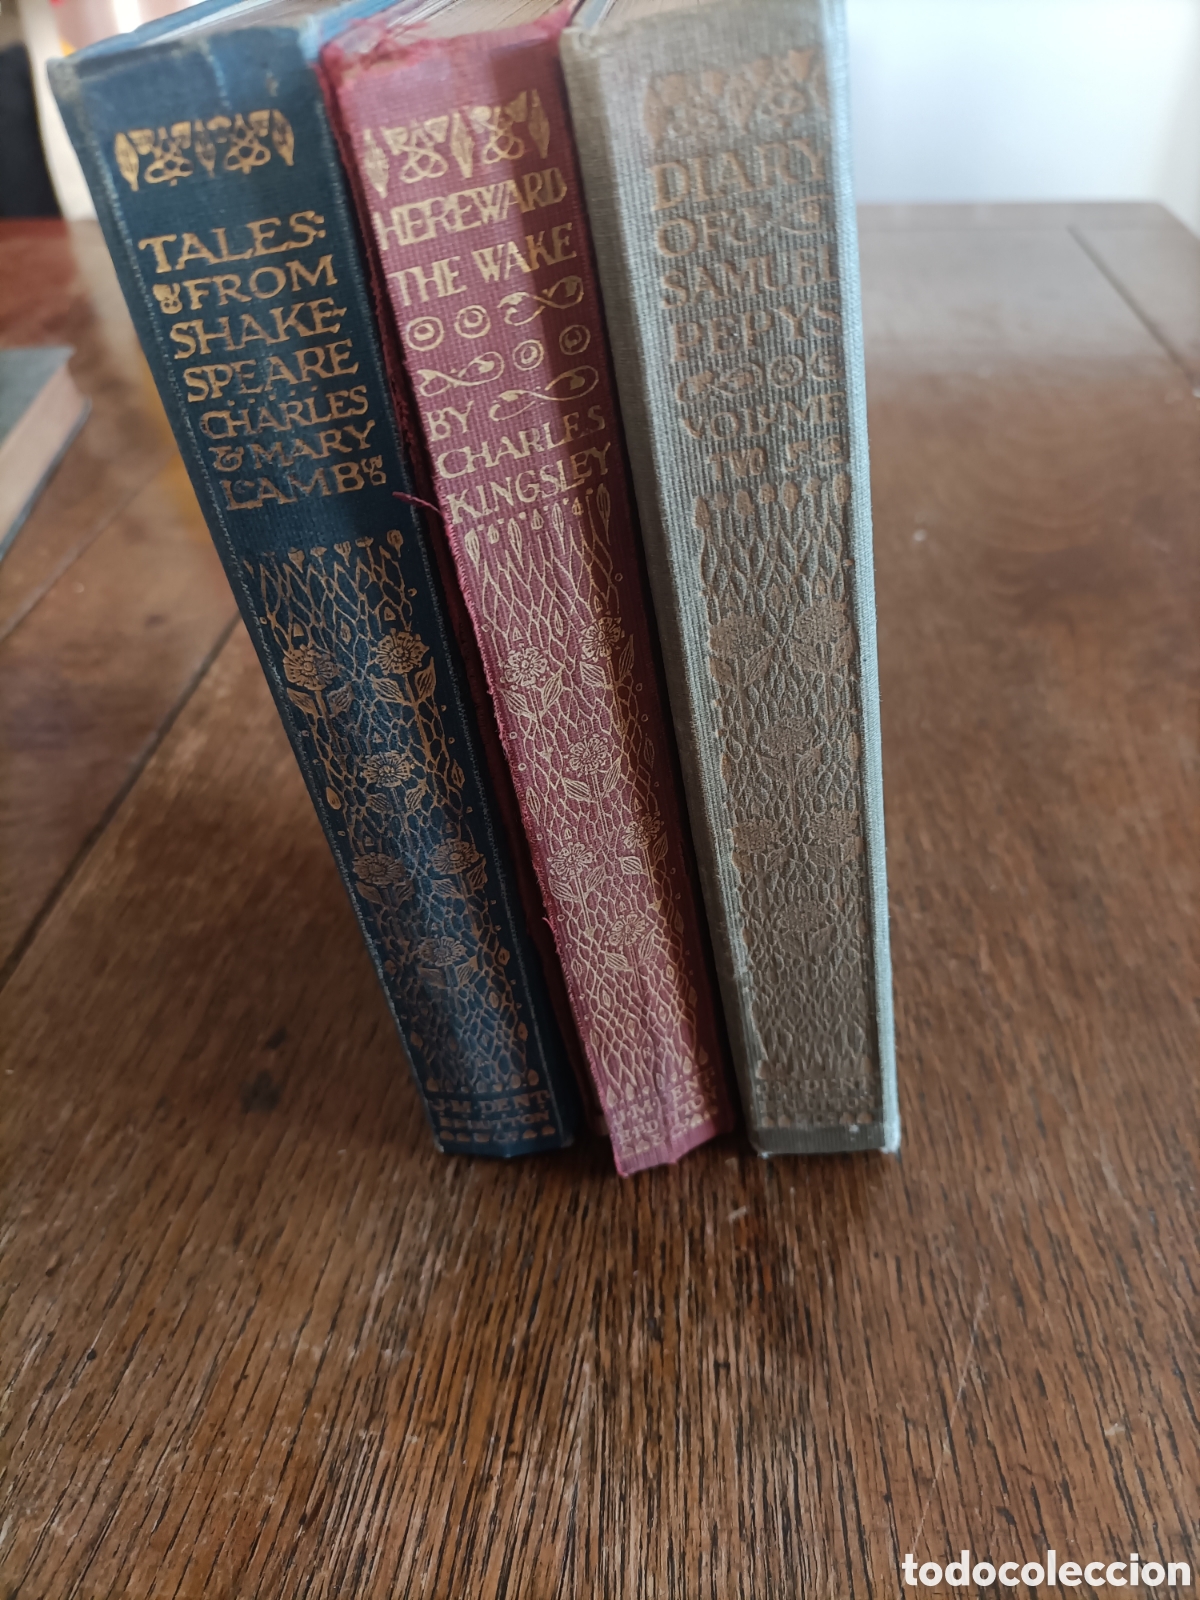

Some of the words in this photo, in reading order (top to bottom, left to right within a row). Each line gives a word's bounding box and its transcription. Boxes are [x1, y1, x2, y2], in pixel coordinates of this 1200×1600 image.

[646, 138, 826, 211] DIARY
[373, 167, 567, 251] HEREWARD
[182, 254, 338, 310] FROM
[386, 256, 467, 306] THE
[471, 222, 576, 283] WAKE
[663, 245, 839, 310] SAMUEL
[673, 300, 842, 362] PEPYS
[183, 338, 359, 402] SPEARE
[200, 385, 368, 440] CHARLES
[425, 401, 474, 442] BY
[437, 405, 606, 479] CHARLES
[209, 445, 244, 472] &
[248, 420, 376, 469] MARY
[446, 442, 611, 525] KINGSLEY
